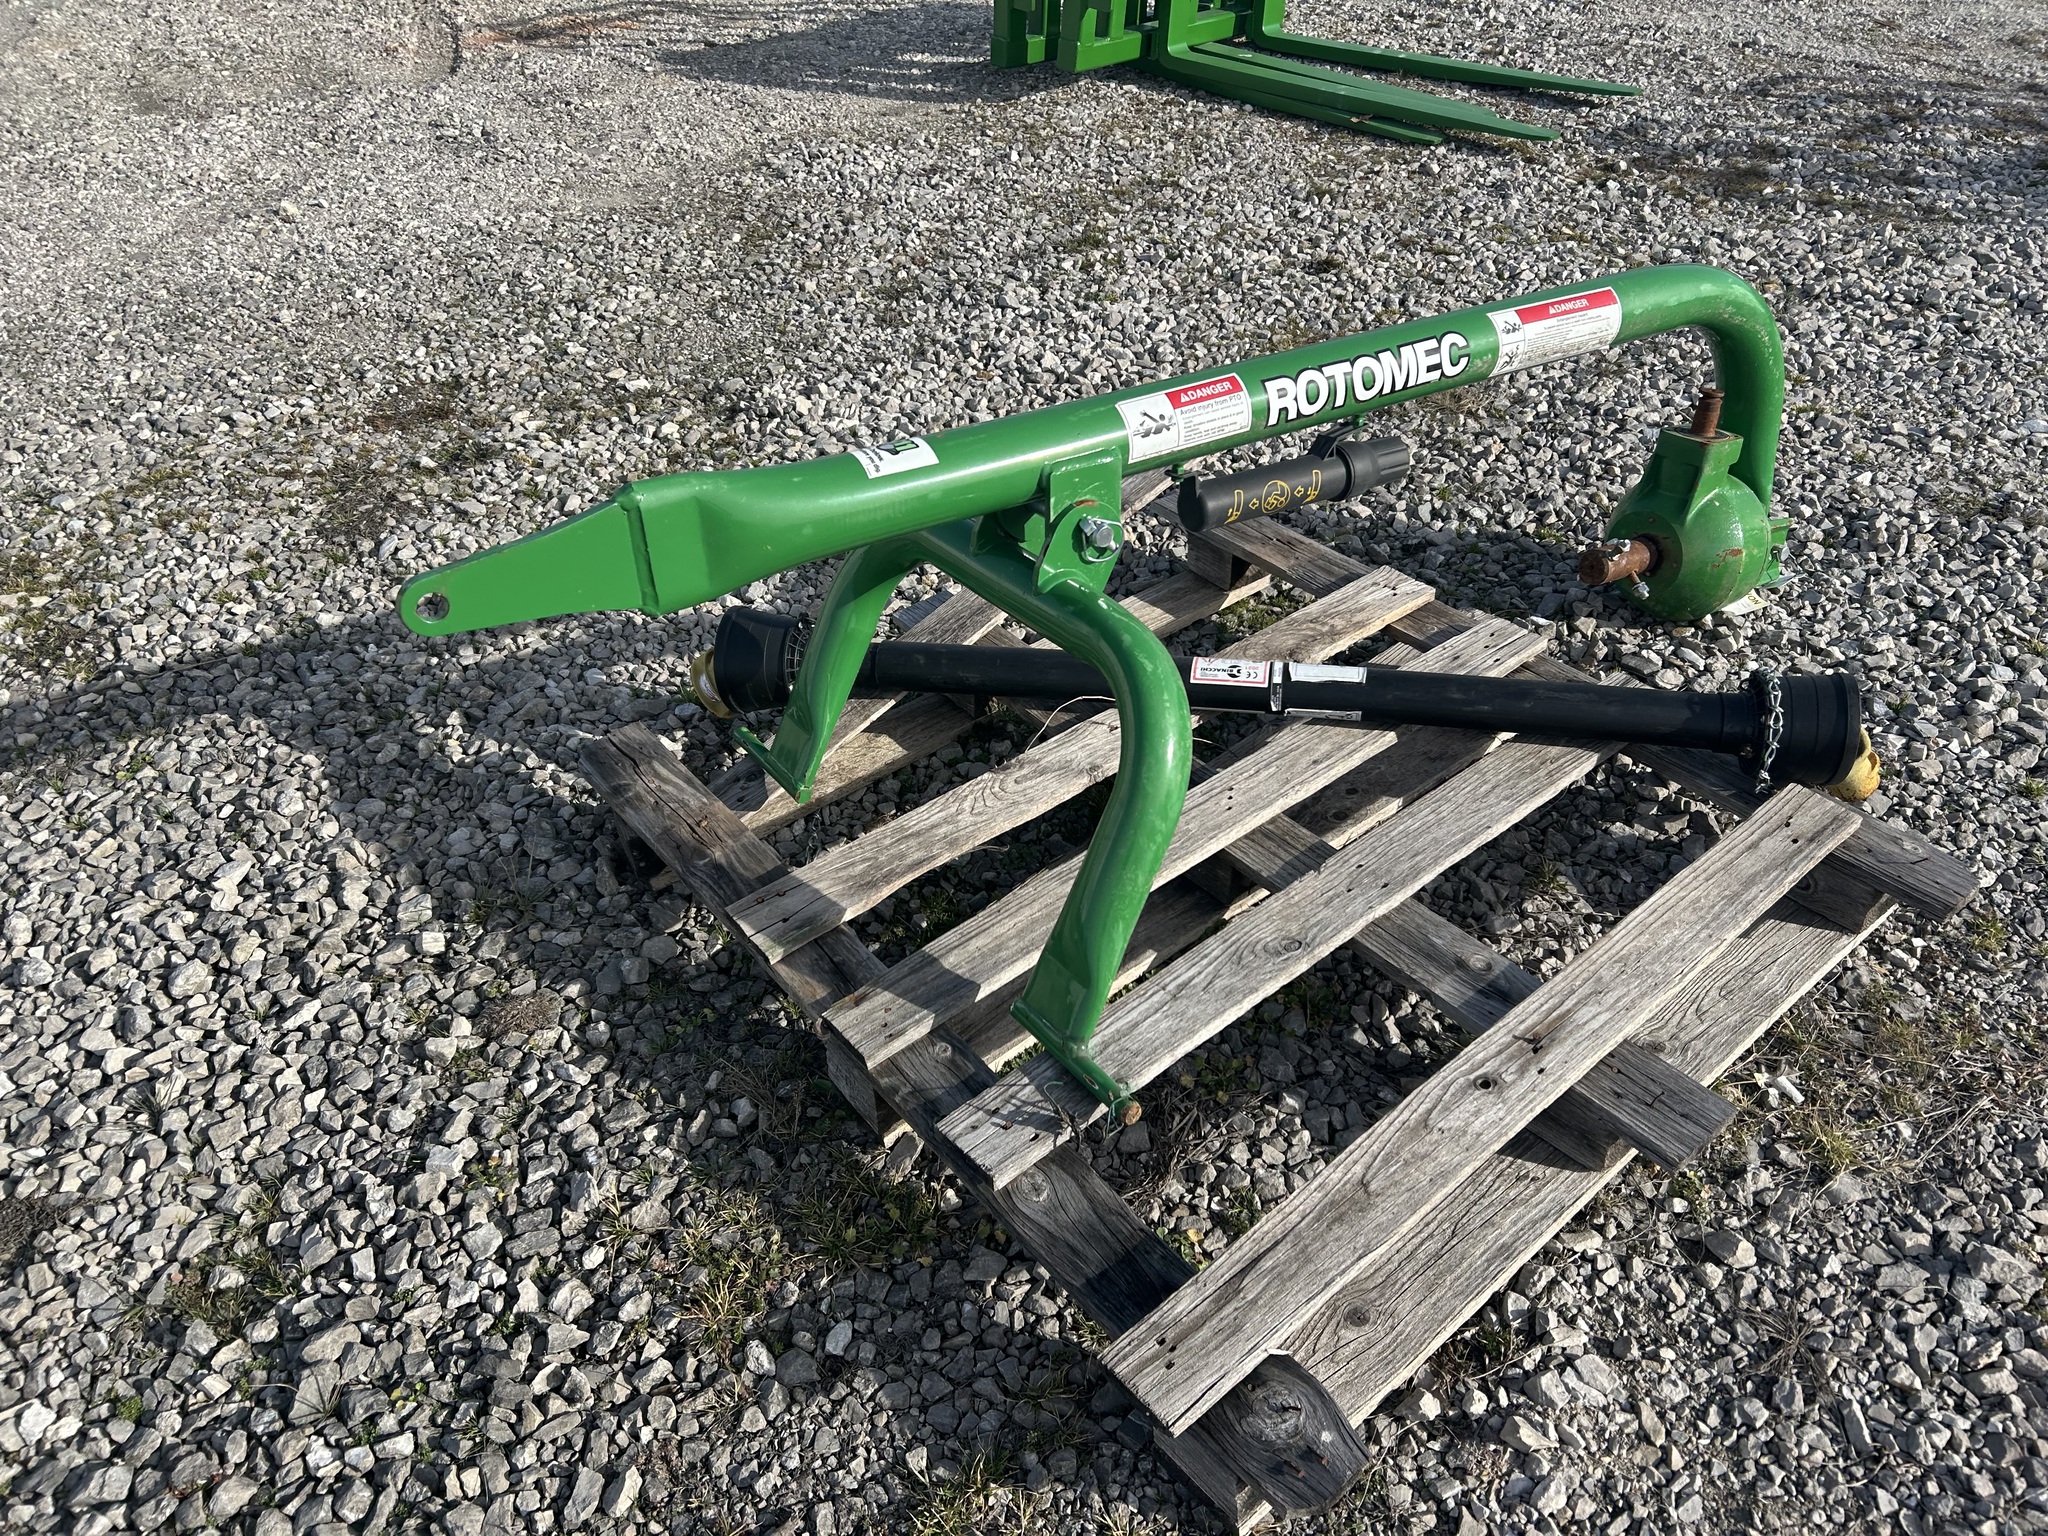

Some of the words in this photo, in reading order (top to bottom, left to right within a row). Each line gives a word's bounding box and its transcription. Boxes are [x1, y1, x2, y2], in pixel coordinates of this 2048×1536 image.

[1554, 298, 1589, 313] DANGER
[1262, 331, 1471, 428] ROTOMEC
[1187, 381, 1233, 400] DANGER
[1180, 406, 1196, 415] Avoid
[1198, 402, 1214, 412] injury
[1214, 398, 1229, 407] from
[1229, 393, 1242, 402] PTO
